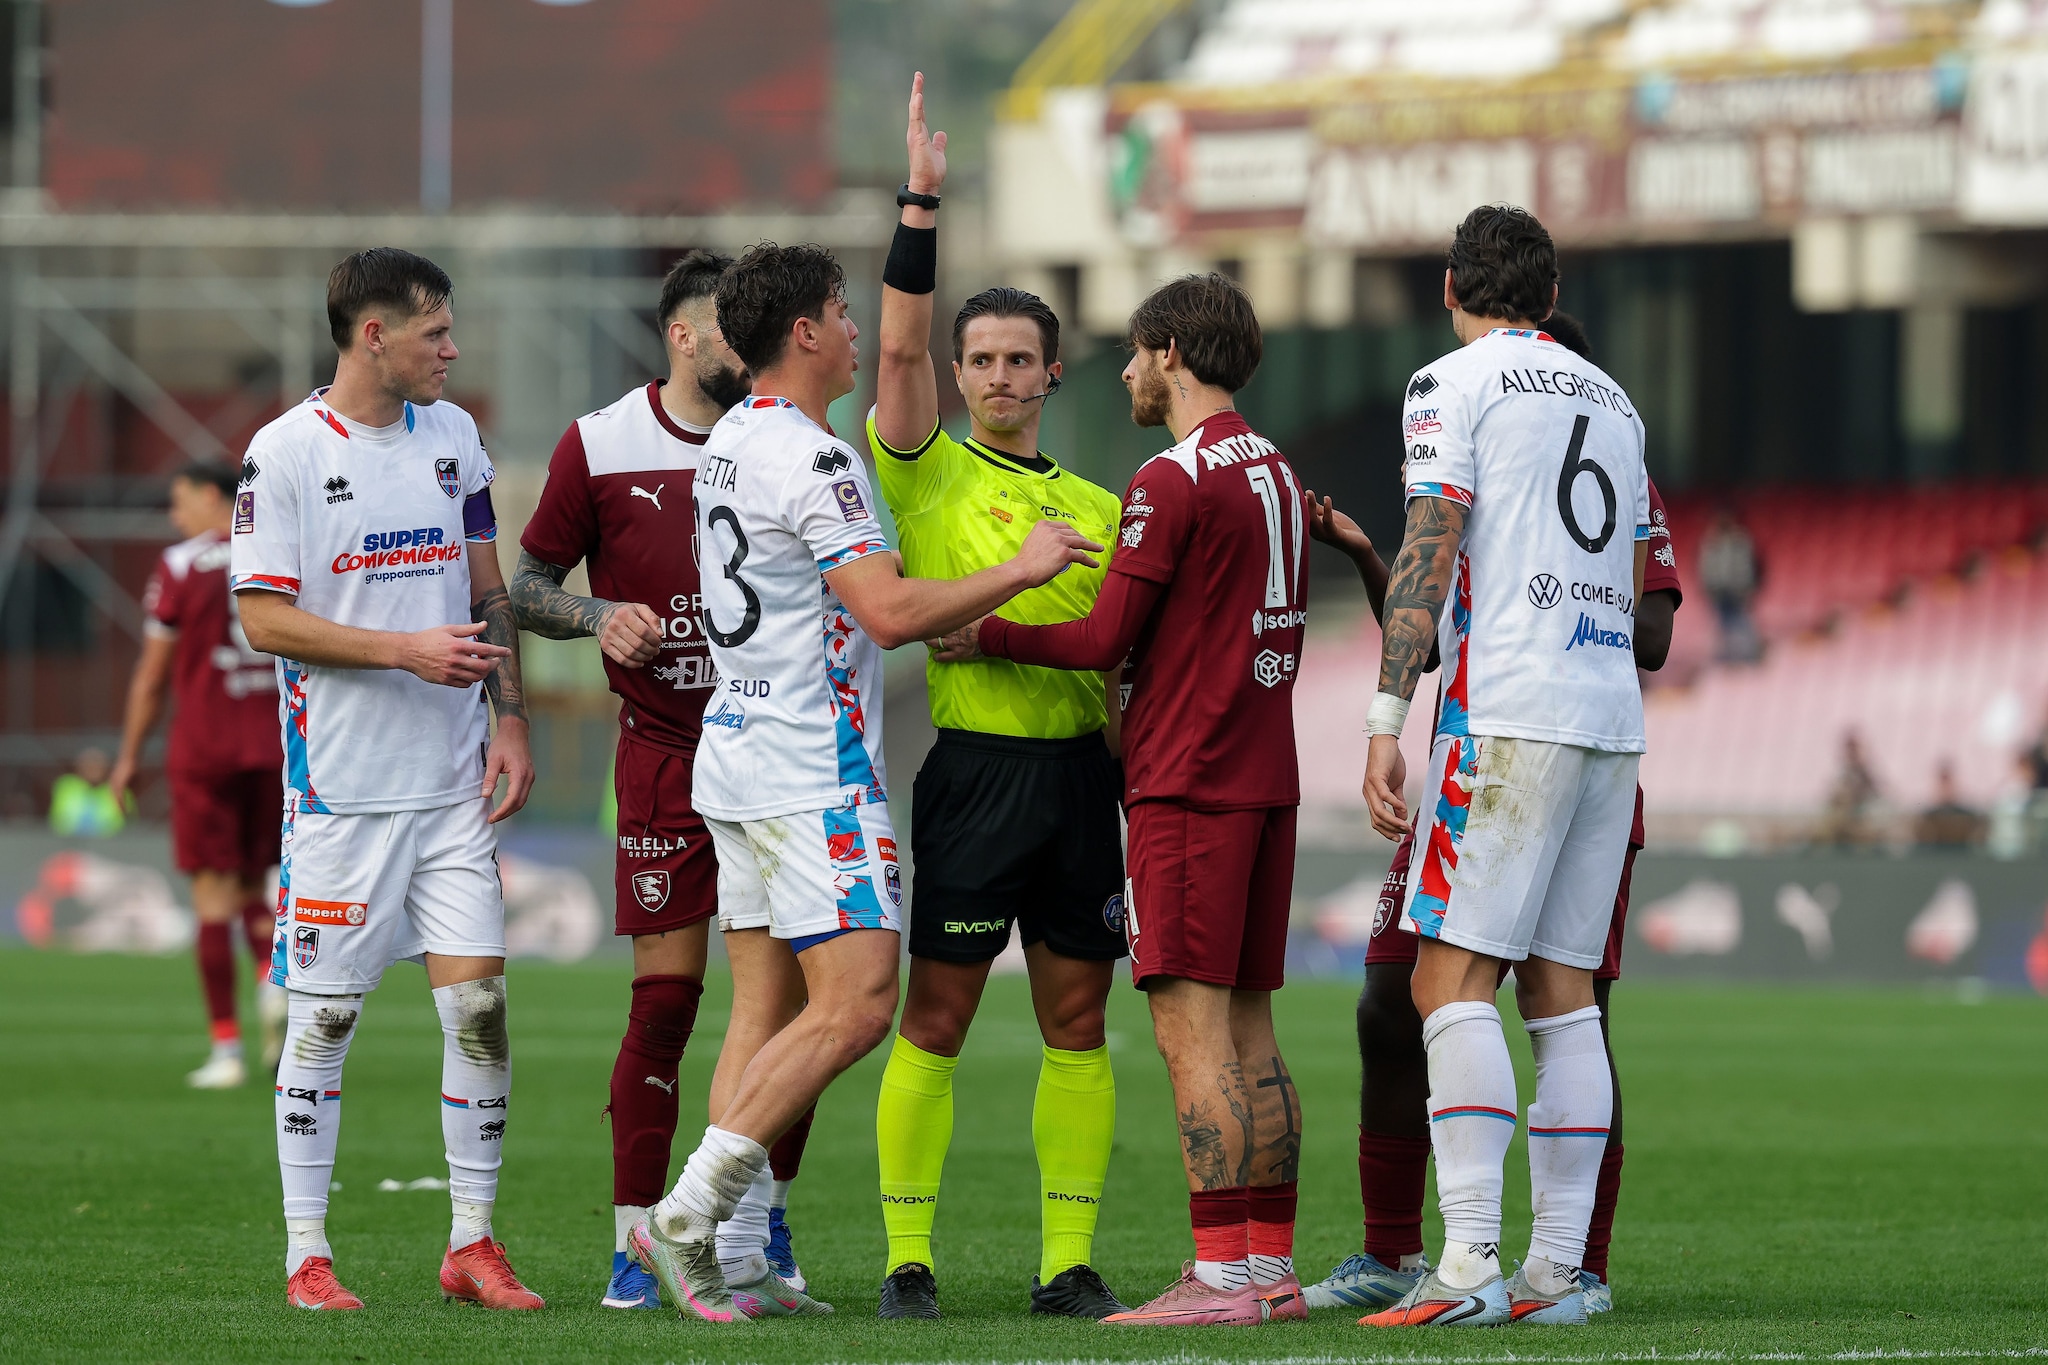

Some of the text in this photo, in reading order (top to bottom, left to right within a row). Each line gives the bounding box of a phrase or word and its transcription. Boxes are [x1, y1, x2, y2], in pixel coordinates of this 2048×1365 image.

[1198, 432, 1281, 471] ANTON
[838, 483, 858, 504] C
[1557, 414, 1617, 553] 6
[327, 491, 354, 505] errea
[363, 527, 444, 552] SUPER
[1245, 461, 1304, 609] 11
[365, 564, 445, 585] gruppoarena.it
[693, 496, 761, 648] 3
[730, 680, 771, 698] SUD
[296, 906, 343, 918] expert
[944, 919, 1006, 934] GIVOVA
[284, 1124, 317, 1136] errea
[882, 1194, 936, 1204] GIVOVA
